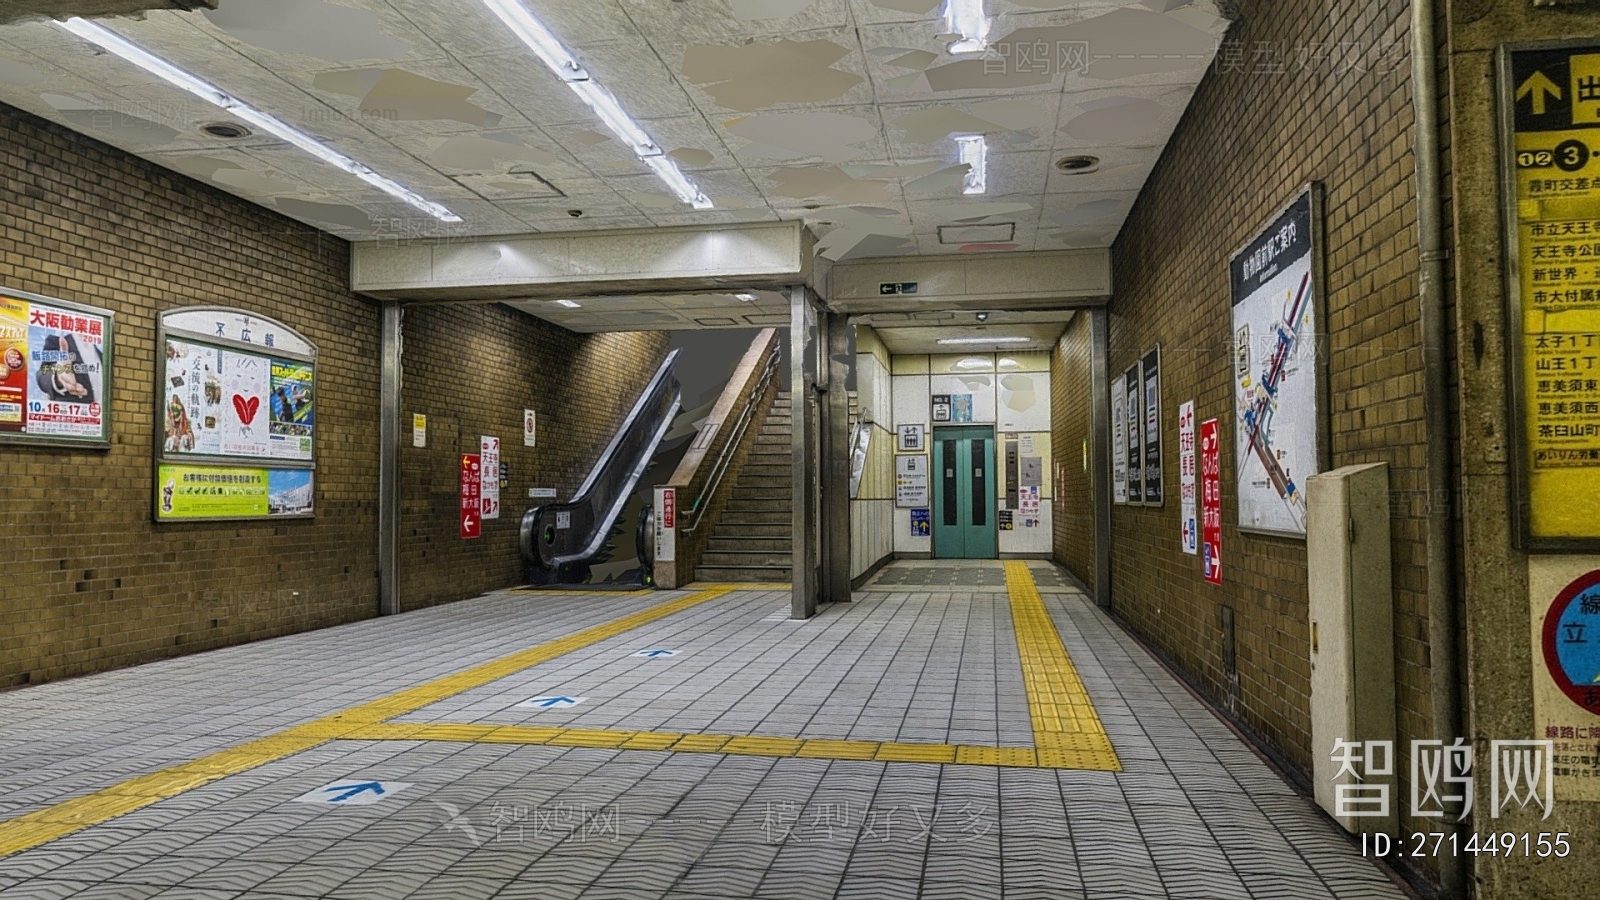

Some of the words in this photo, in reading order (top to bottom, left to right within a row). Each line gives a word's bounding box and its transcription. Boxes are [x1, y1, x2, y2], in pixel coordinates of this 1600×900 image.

[30, 310, 102, 336] 大阪勧業展
[83, 335, 102, 345] 2019
[48, 403, 60, 413] 16
[69, 405, 80, 415] 17
